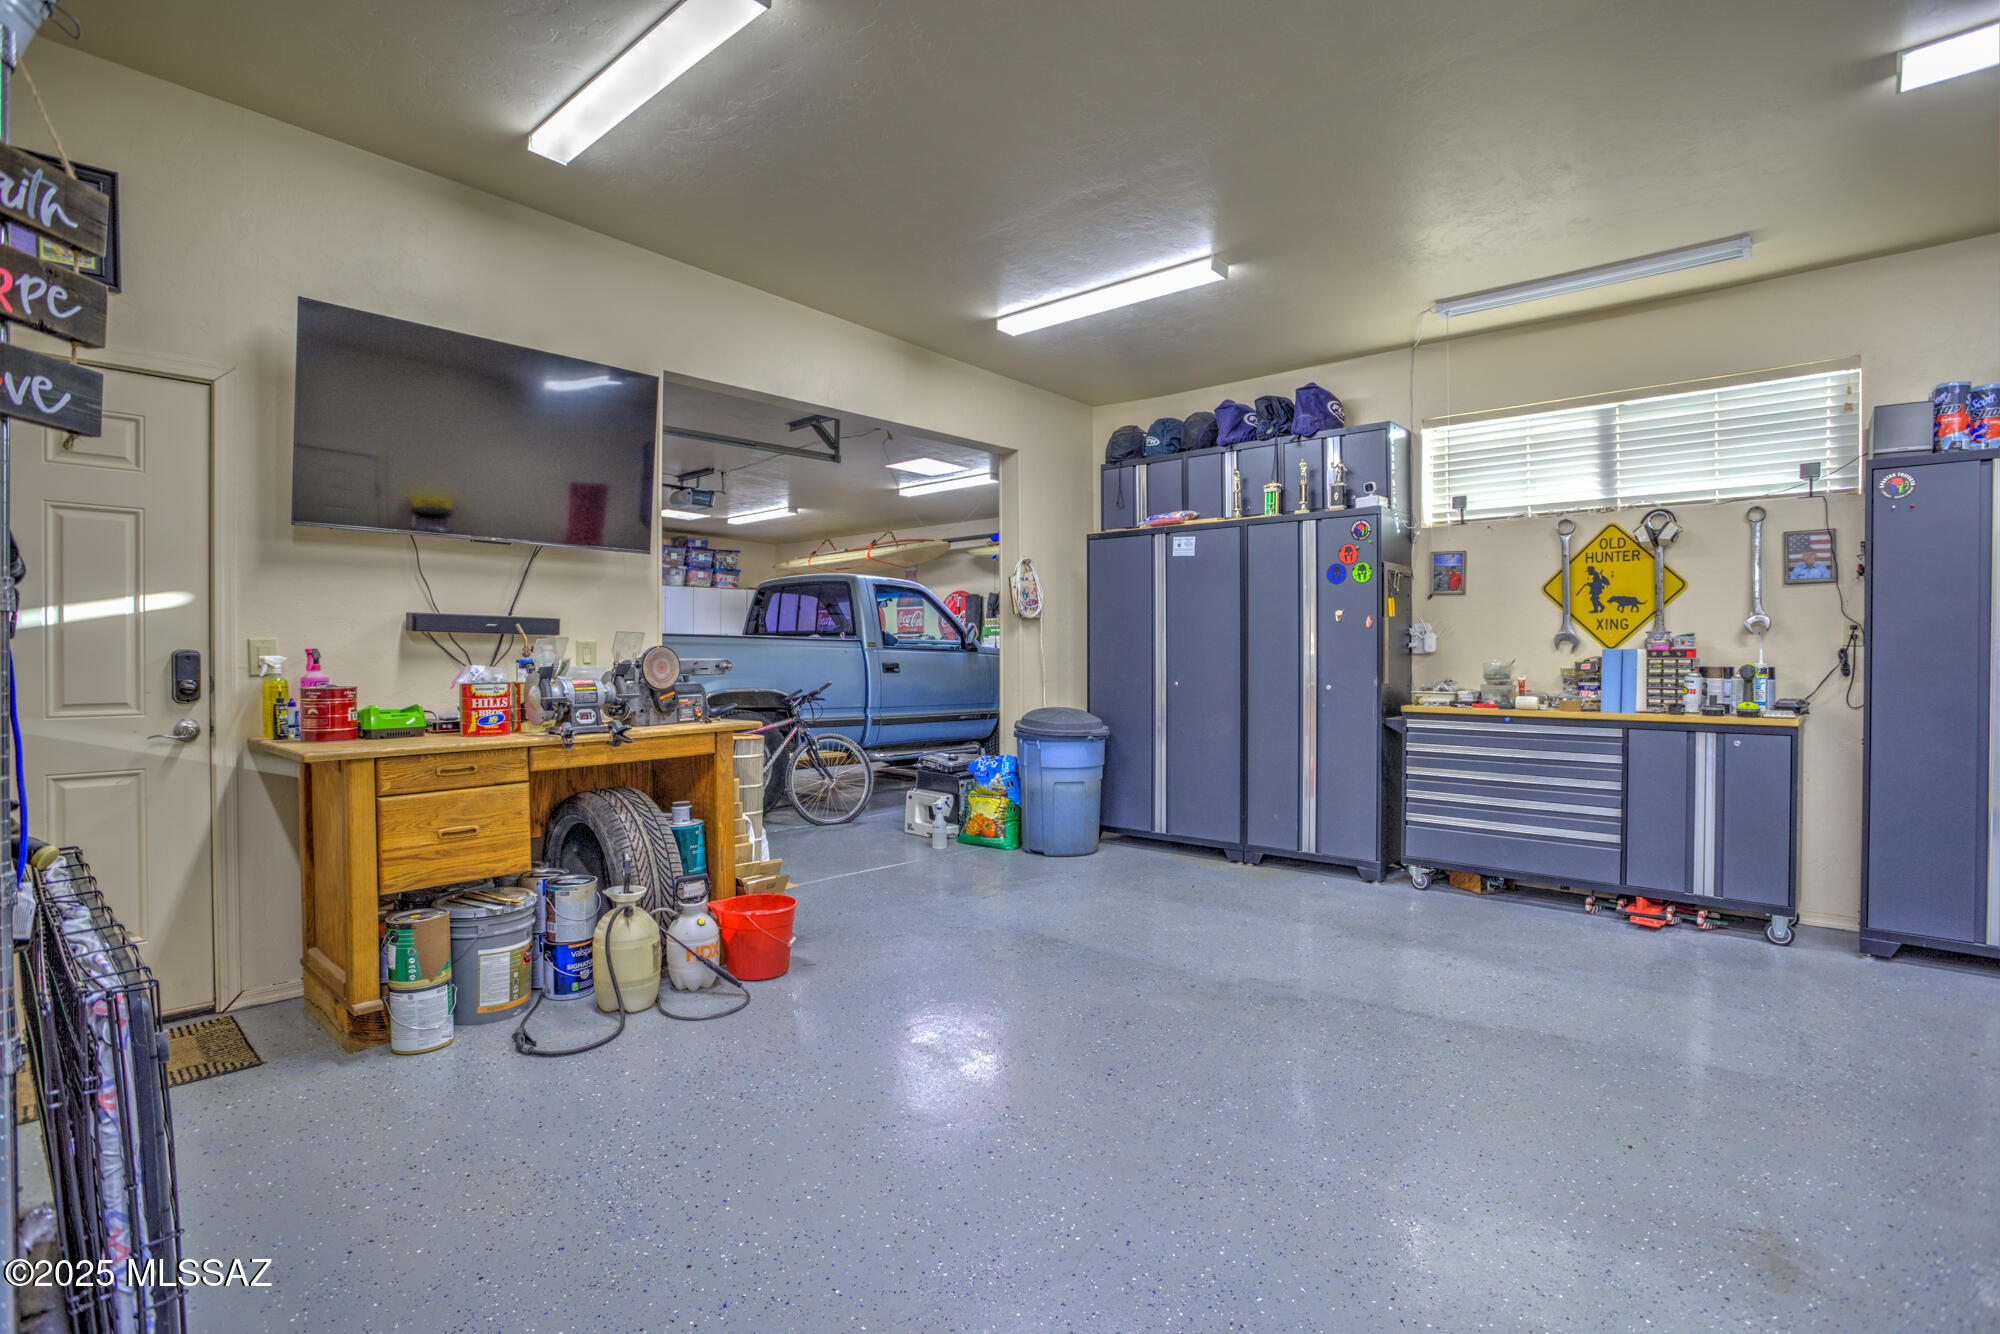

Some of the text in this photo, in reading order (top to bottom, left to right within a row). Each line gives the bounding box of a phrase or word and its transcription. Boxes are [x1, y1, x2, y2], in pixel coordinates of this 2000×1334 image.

[1971, 407, 2000, 420] SHO
[1599, 537, 1627, 550] OLD
[1585, 550, 1641, 564] HUNTER
[1596, 618, 1629, 631] XING
[471, 697, 508, 708] HILLS
[686, 941, 719, 963] HDX
